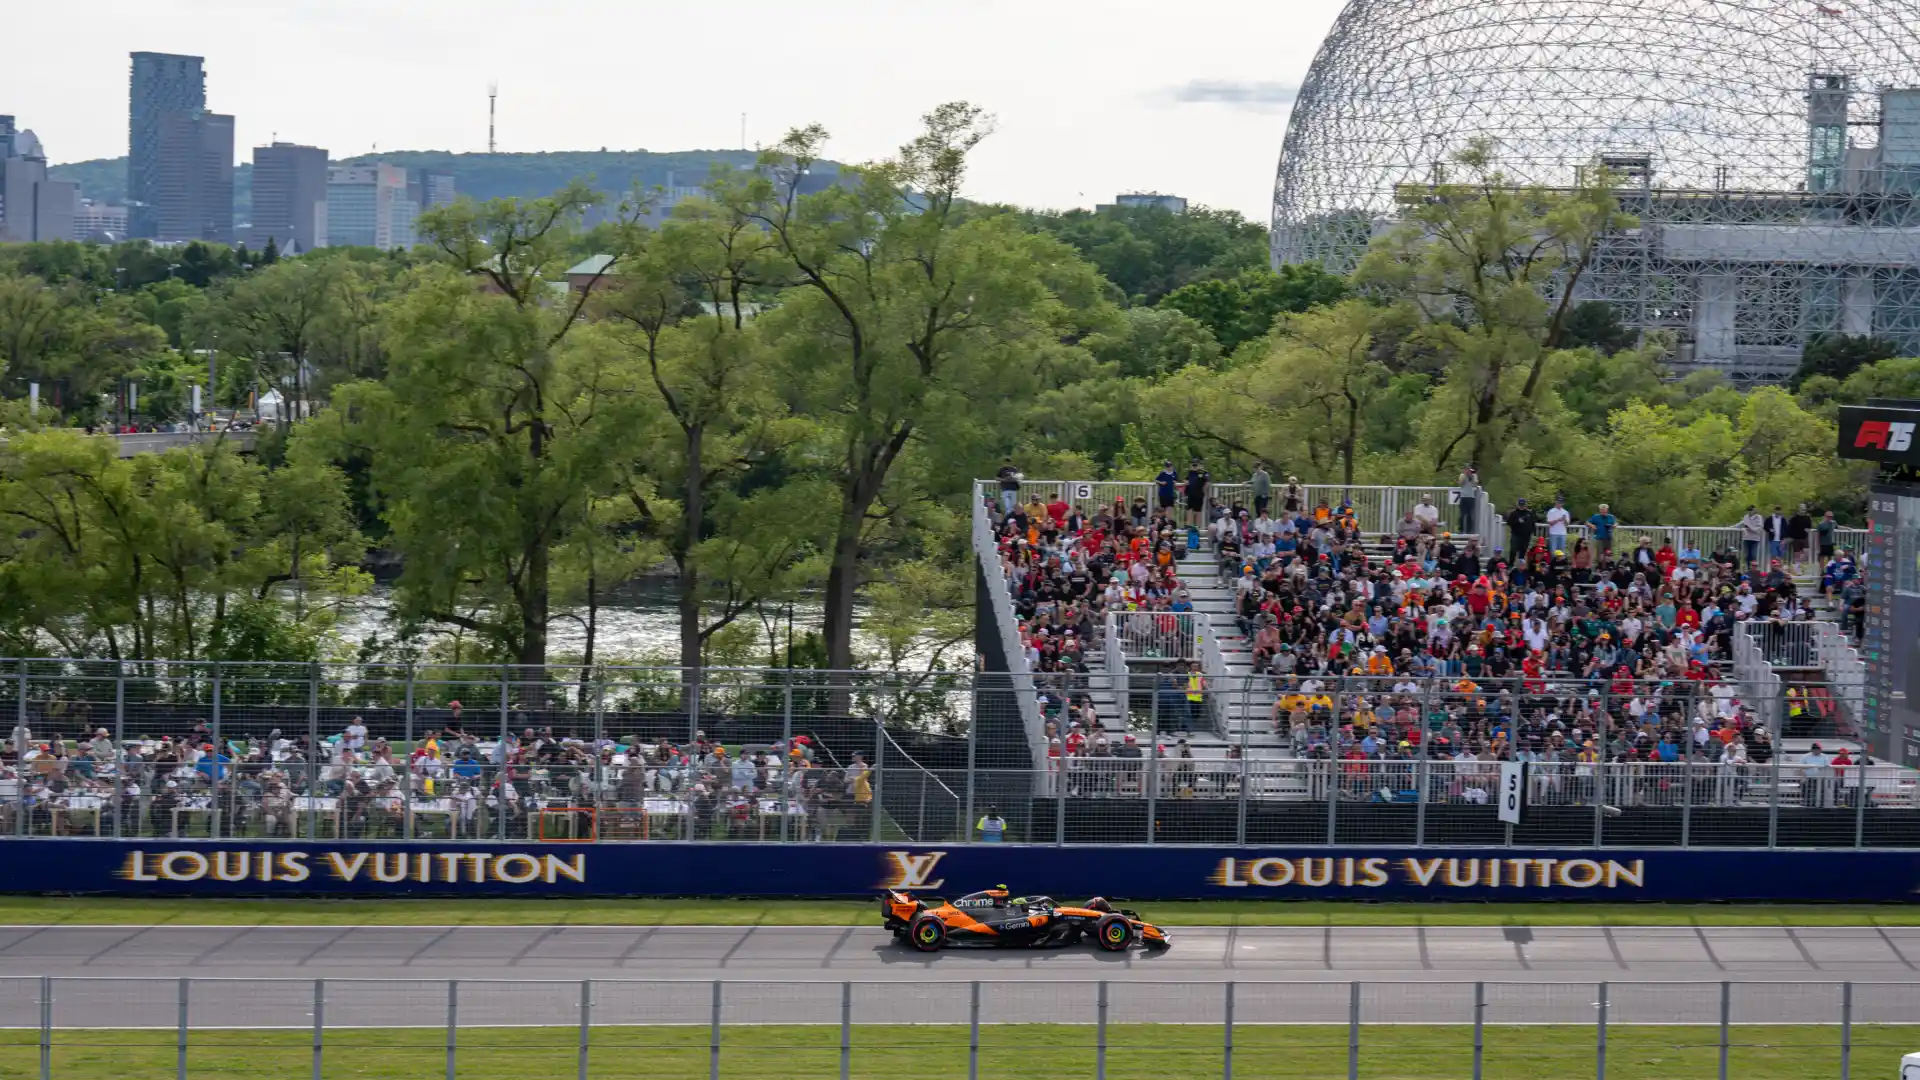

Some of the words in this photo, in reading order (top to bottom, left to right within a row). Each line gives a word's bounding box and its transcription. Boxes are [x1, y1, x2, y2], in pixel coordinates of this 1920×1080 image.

[1078, 485, 1089, 498] 6
[1451, 490, 1461, 503] 7
[1508, 773, 1517, 811] 50
[132, 851, 310, 883] LOUIS
[330, 851, 586, 884] VUITTON
[1224, 857, 1389, 887] LOUIS
[1406, 857, 1644, 888] VUITTON
[953, 898, 994, 908] Chrome
[1005, 921, 1030, 930] Gemini
